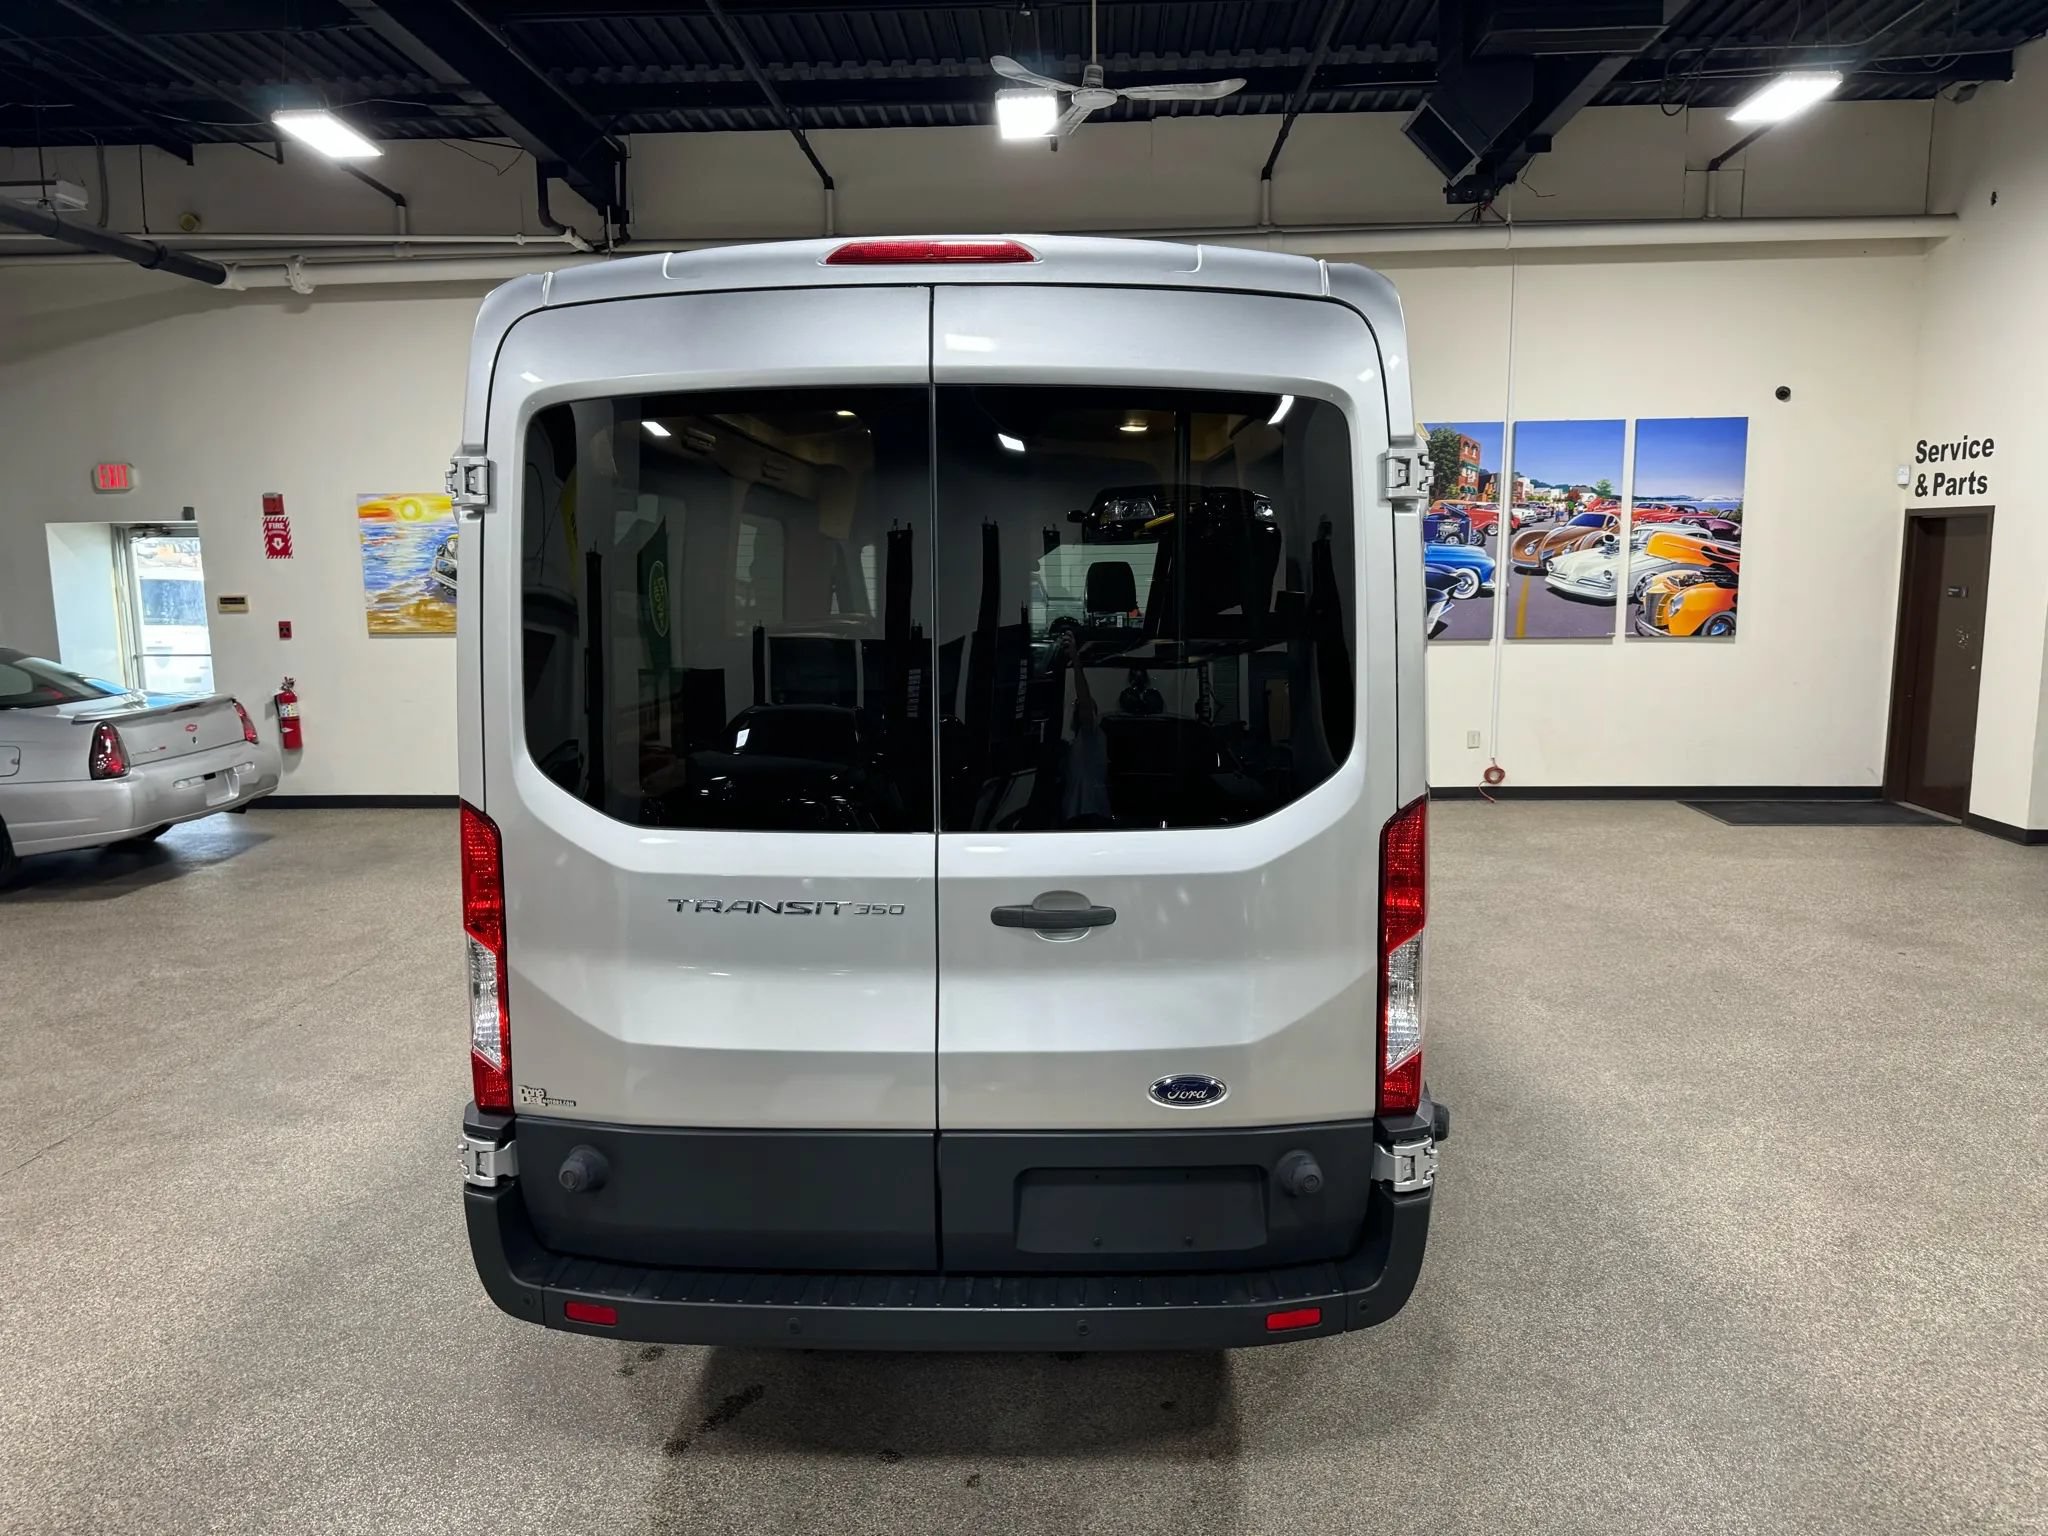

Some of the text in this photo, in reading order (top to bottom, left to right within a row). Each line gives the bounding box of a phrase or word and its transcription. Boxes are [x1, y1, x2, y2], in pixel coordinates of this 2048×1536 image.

[1915, 435, 1995, 464] Service
[98, 463, 129, 489] EXIT
[1915, 470, 1988, 498] & Parts
[267, 522, 286, 530] FIRE
[667, 898, 906, 916] TRANSIT 350
[1167, 1082, 1209, 1100] Ford
